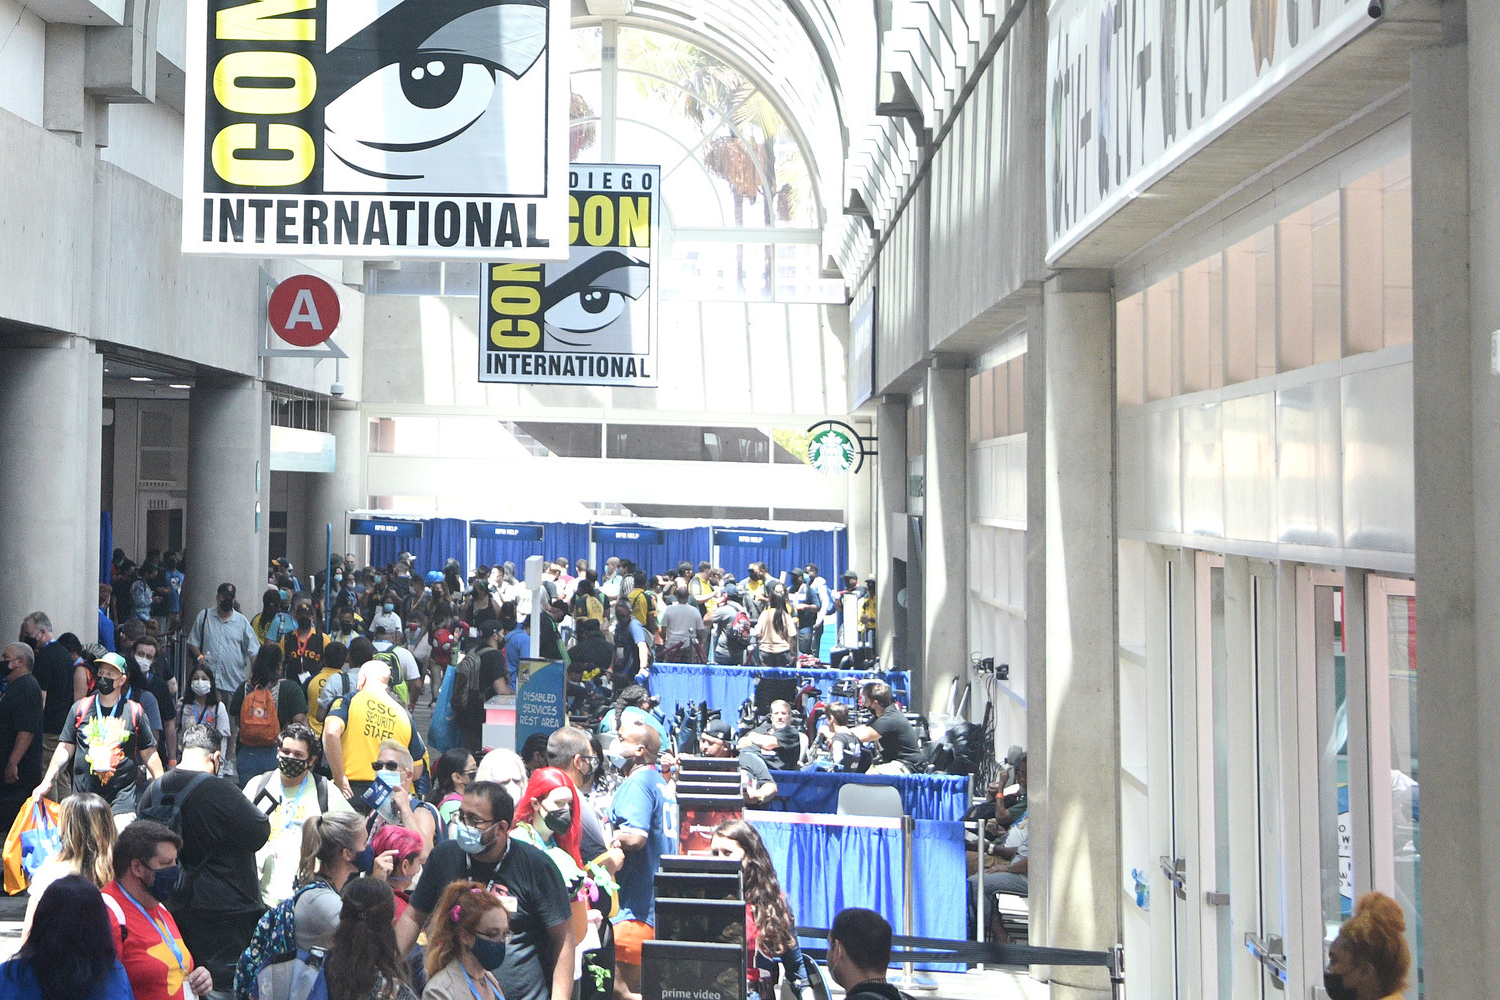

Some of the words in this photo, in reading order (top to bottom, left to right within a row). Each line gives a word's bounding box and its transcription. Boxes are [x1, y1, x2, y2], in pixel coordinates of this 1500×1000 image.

[569, 172, 653, 190] DIEGO
[202, 197, 550, 248] INTERNATIONAL
[284, 289, 323, 331] A
[486, 353, 651, 378] INTERNATIONAL
[523, 691, 557, 703] DISABLED
[367, 699, 397, 718] CSC
[522, 703, 557, 716] SERVICES
[365, 711, 396, 731] SECURITY
[519, 715, 539, 726] REST
[541, 717, 559, 728] AREA
[363, 724, 394, 742] STAFF
[662, 988, 691, 1000] prime
[693, 989, 721, 1000] video
